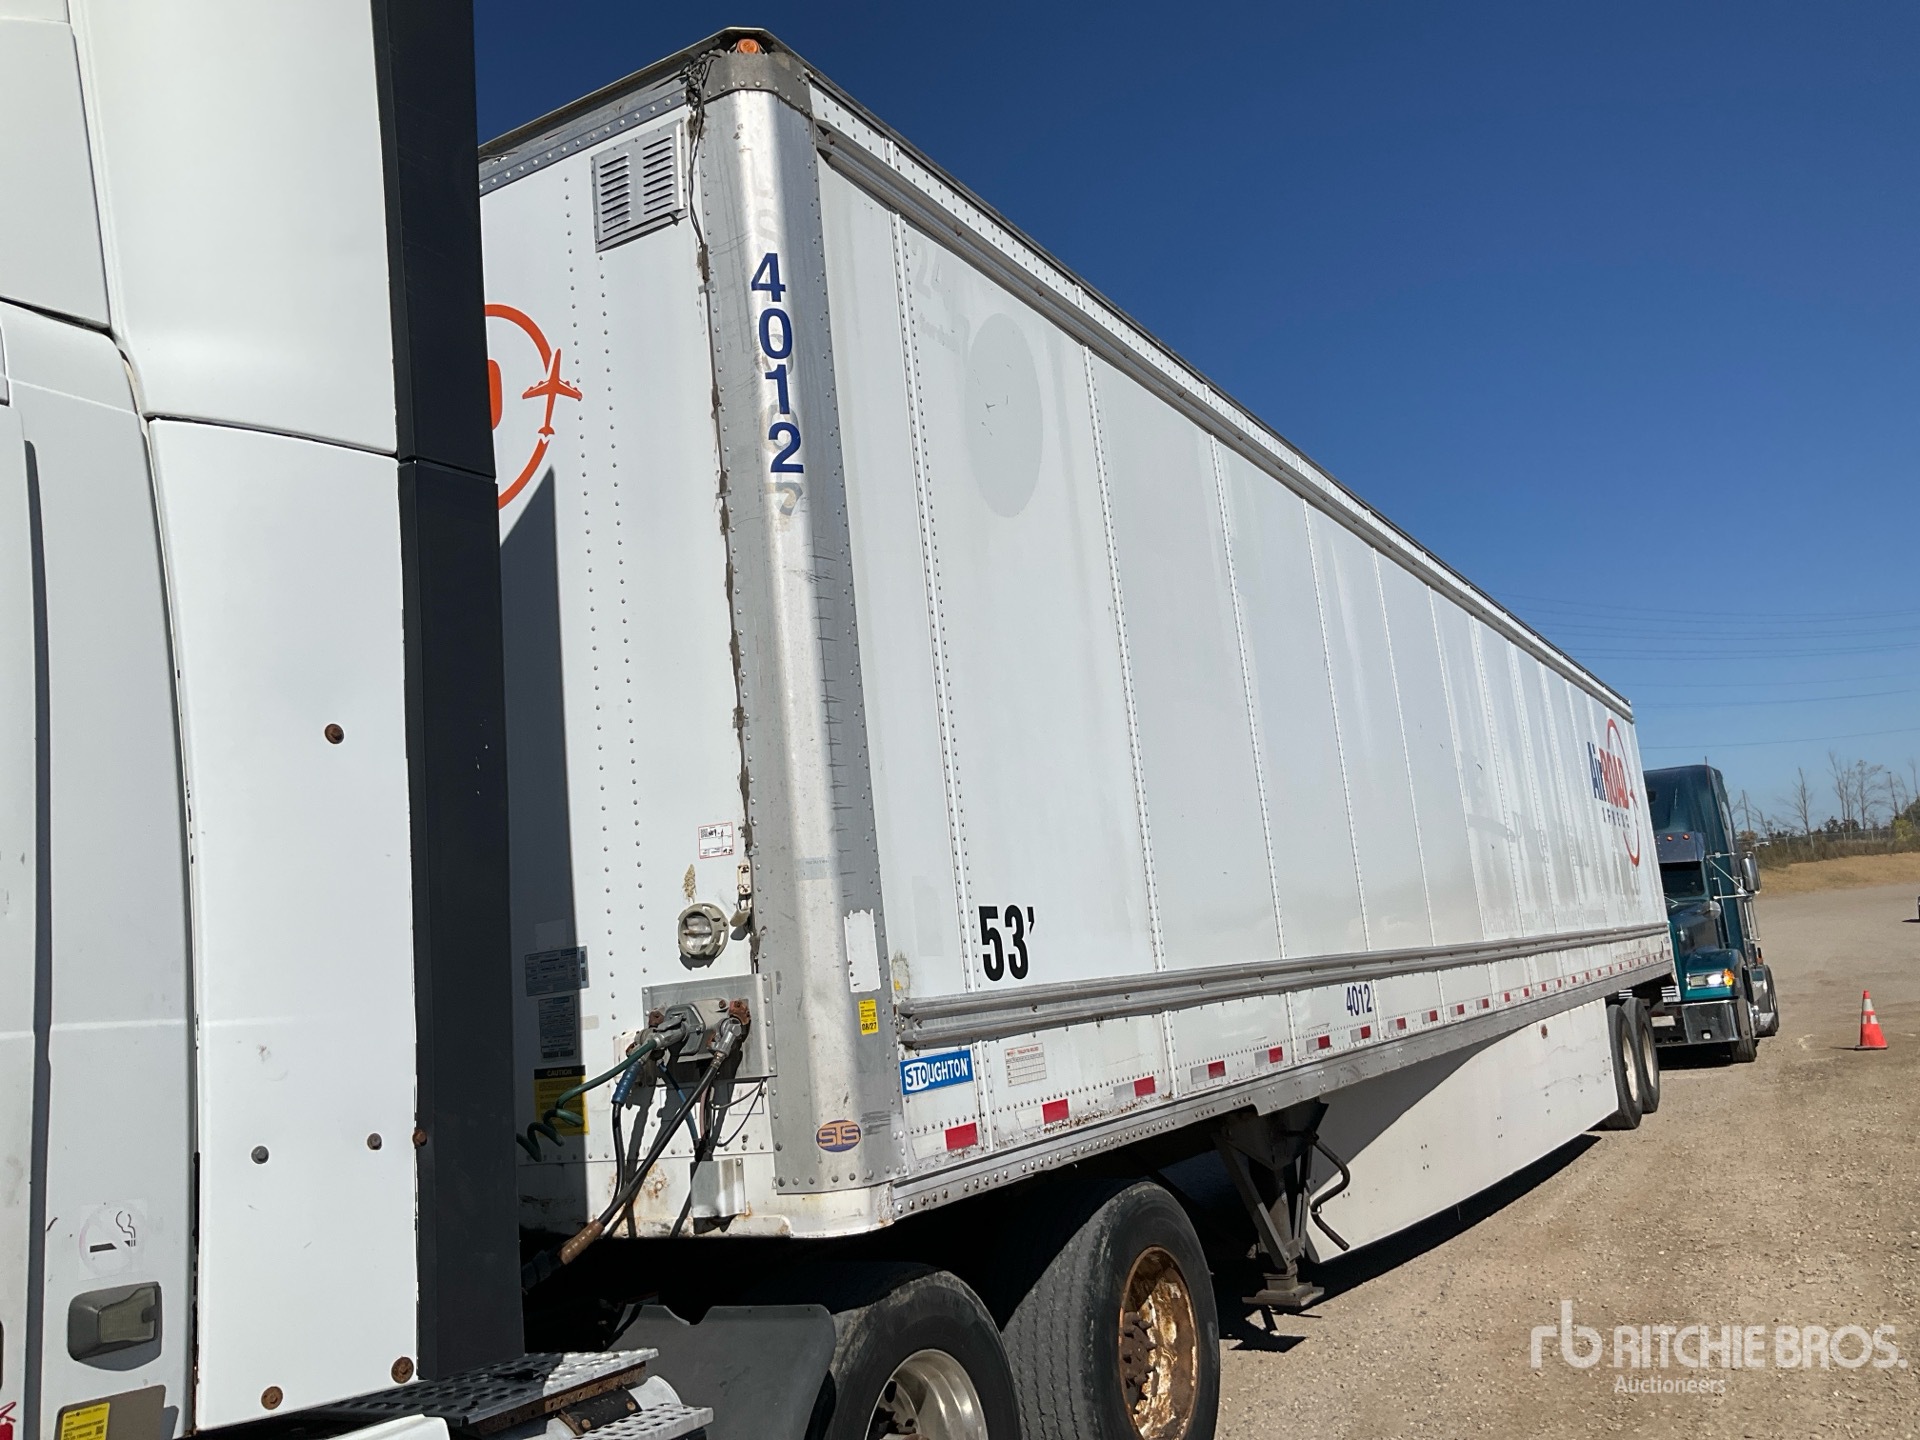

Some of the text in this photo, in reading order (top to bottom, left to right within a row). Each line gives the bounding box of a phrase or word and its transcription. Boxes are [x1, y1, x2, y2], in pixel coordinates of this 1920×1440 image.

[751, 252, 804, 474] 4012
[978, 904, 1035, 982] 53'
[1346, 983, 1373, 1016] 4012
[546, 1069, 573, 1077] CAUTION
[905, 1058, 969, 1088] STOUGHTON
[818, 1121, 861, 1148] STS
